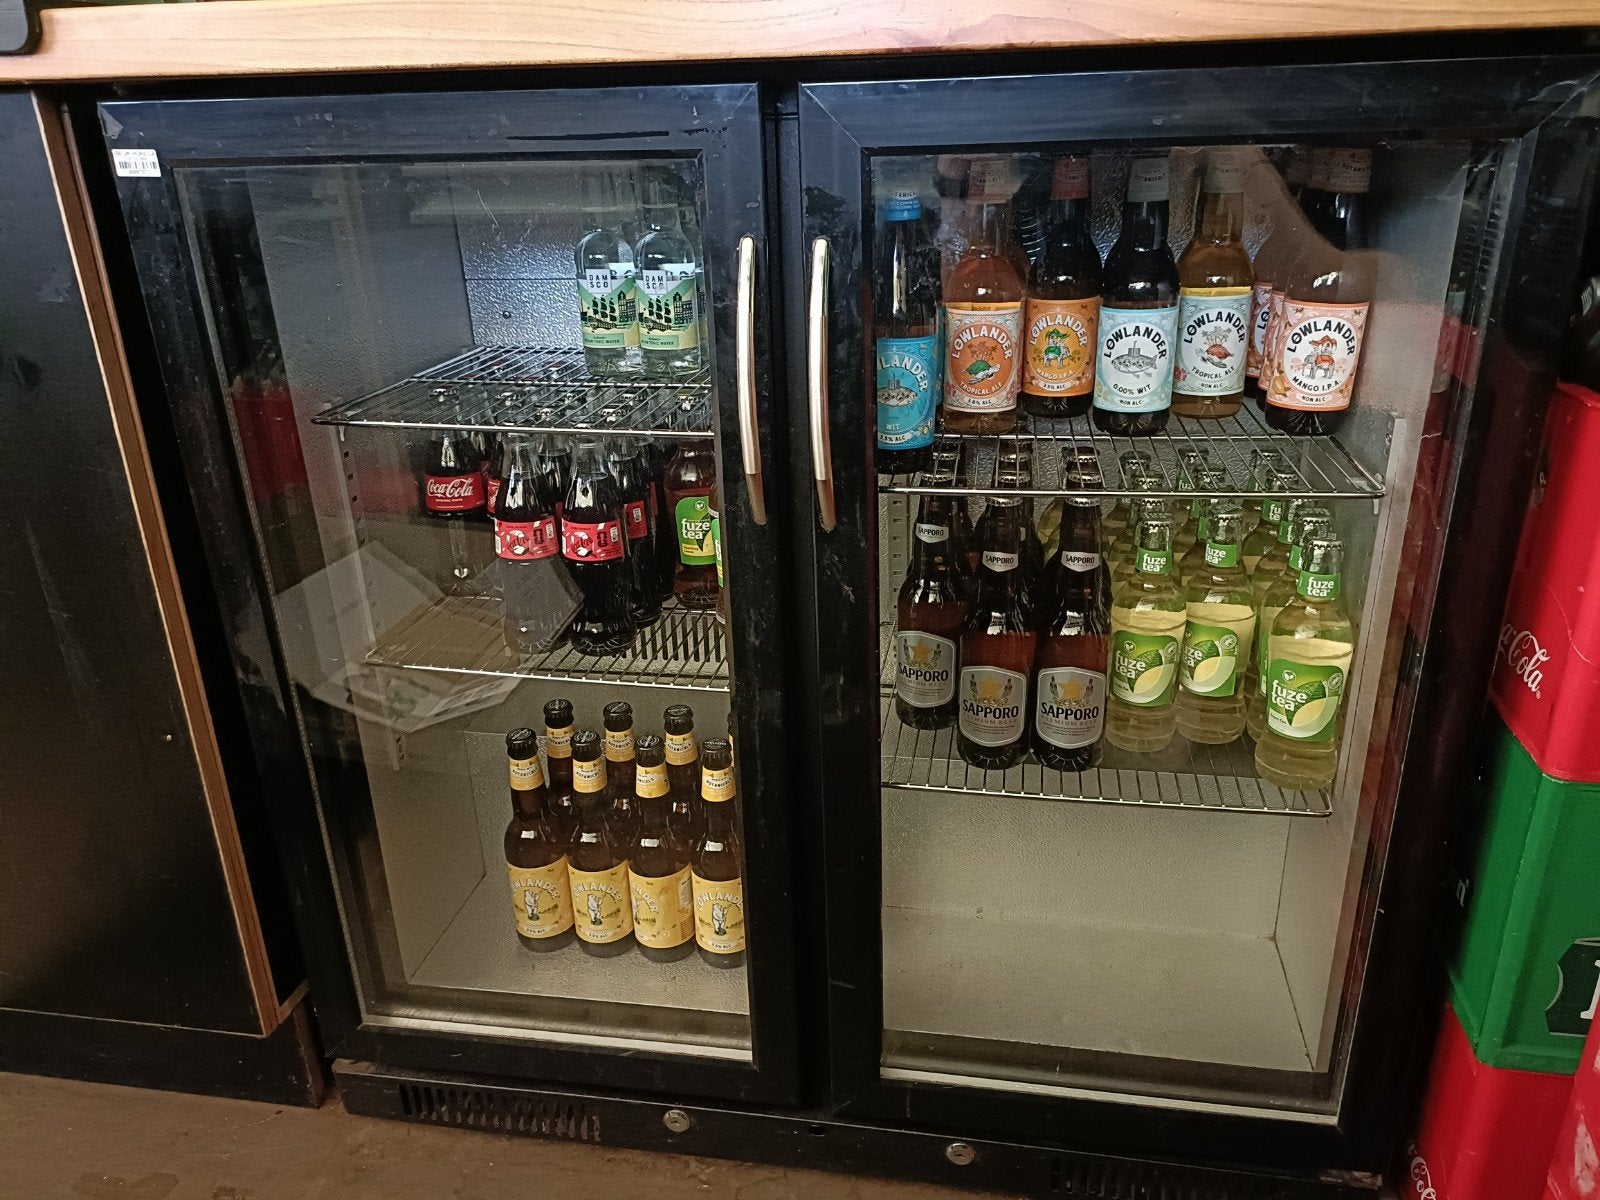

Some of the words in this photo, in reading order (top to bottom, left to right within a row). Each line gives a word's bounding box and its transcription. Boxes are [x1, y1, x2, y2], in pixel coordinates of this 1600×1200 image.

[1030, 314, 1088, 346] LOWLANDER
[1184, 311, 1246, 344] LOWLANDER
[952, 326, 1013, 359] LOWLANDER
[1103, 326, 1167, 359] LOWLANDER
[1287, 322, 1356, 356] LOWLANDER
[877, 355, 928, 391] LANDER
[1036, 368, 1057, 380] MANGO
[1191, 366, 1221, 380] TROPICAL
[1224, 366, 1235, 376] ALE
[960, 381, 989, 395] TROPICAL
[991, 382, 1003, 392] ALE
[1113, 383, 1134, 395] 0.00%
[1136, 384, 1151, 395] WIT
[1291, 376, 1319, 391] MANGO
[428, 478, 474, 498] Coca-Cola
[1269, 512, 1280, 521] te
[1270, 504, 1281, 514] fu
[681, 518, 710, 531] fuze
[918, 526, 944, 537] SAPPORO
[682, 529, 703, 540] tea
[985, 555, 1014, 564] SAPPORO
[1065, 554, 1095, 564] SAPPORO
[1142, 561, 1162, 572] tea
[1143, 553, 1167, 565] fuze
[1308, 577, 1334, 590] fuze
[1307, 586, 1328, 597] tea
[1115, 650, 1146, 671] fuze
[1184, 646, 1203, 661] ze
[899, 662, 949, 682] SAPPORO
[1115, 663, 1136, 679] tea
[1273, 679, 1307, 703] fuze
[1271, 691, 1295, 711] tea
[962, 699, 1019, 720] SAPPORO
[1041, 701, 1099, 721] SAPPORO
